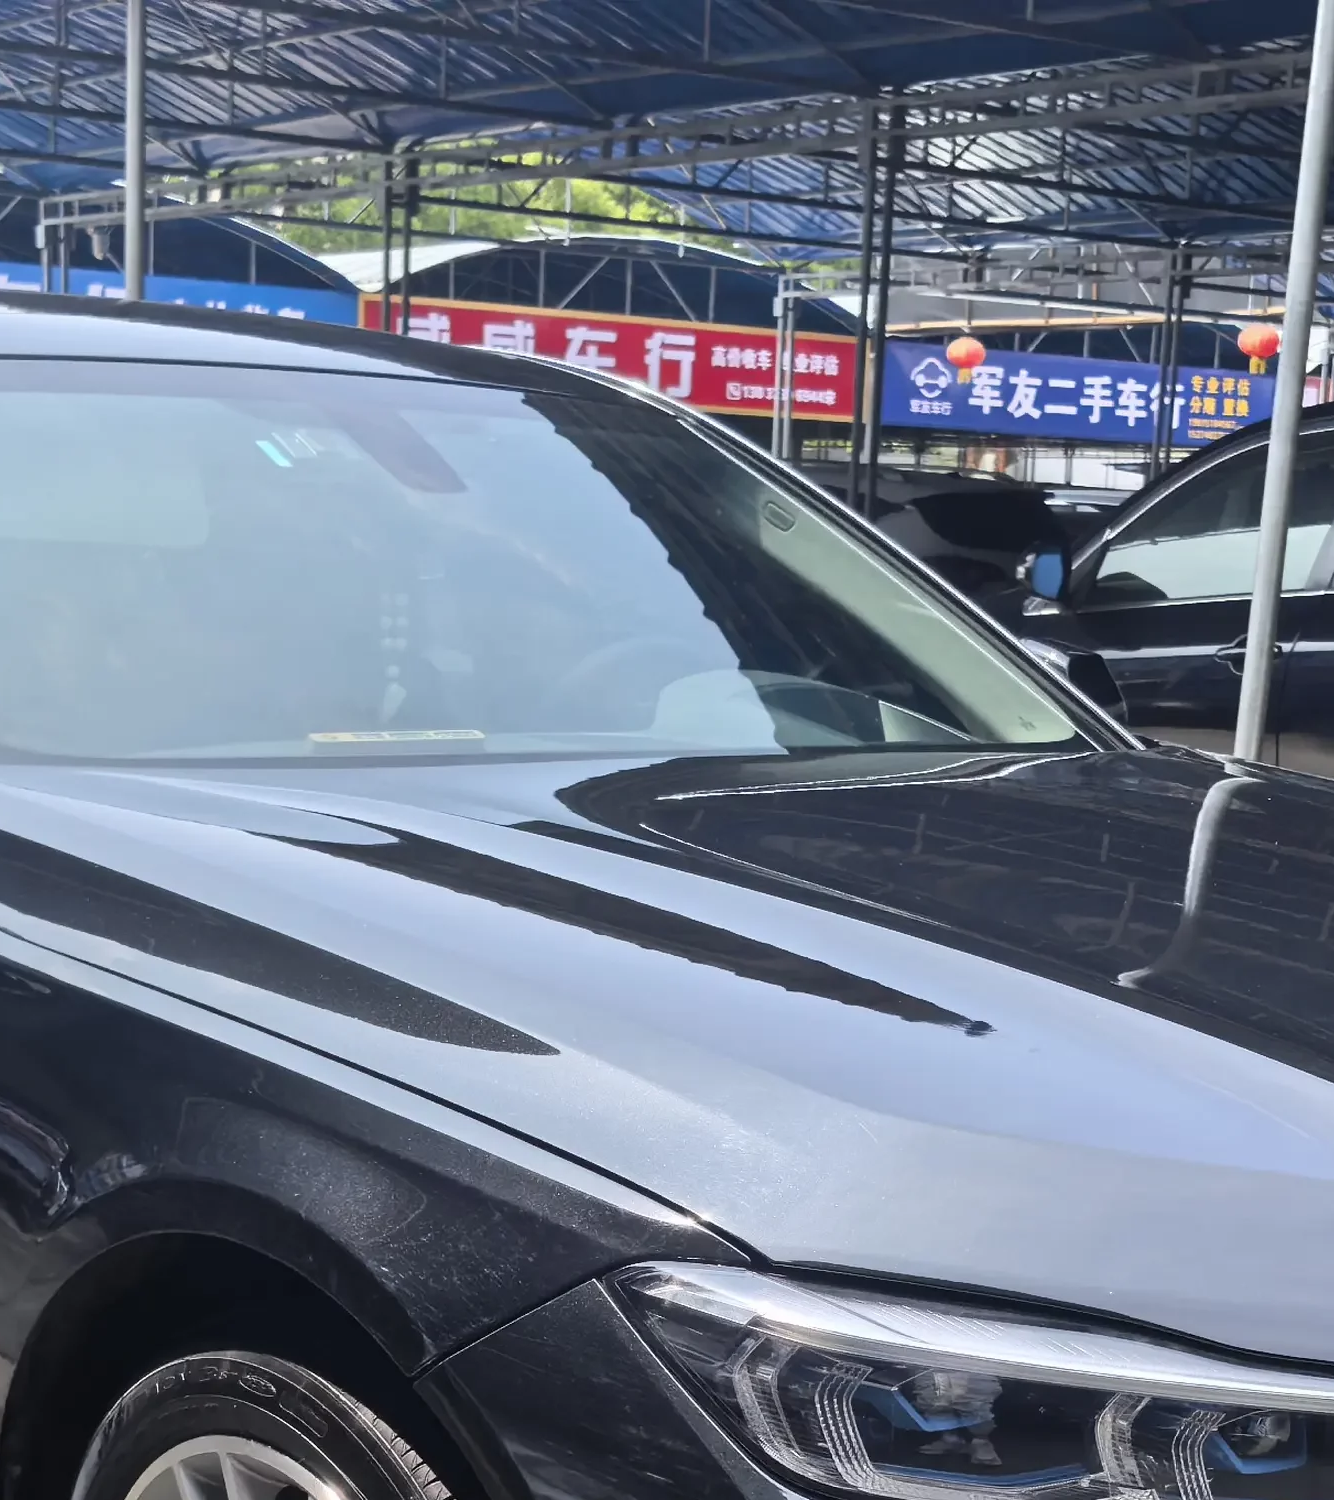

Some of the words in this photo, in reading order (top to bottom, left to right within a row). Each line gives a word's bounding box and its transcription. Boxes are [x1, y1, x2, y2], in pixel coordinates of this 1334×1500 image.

[968, 366, 1184, 429] 军友二手车行
